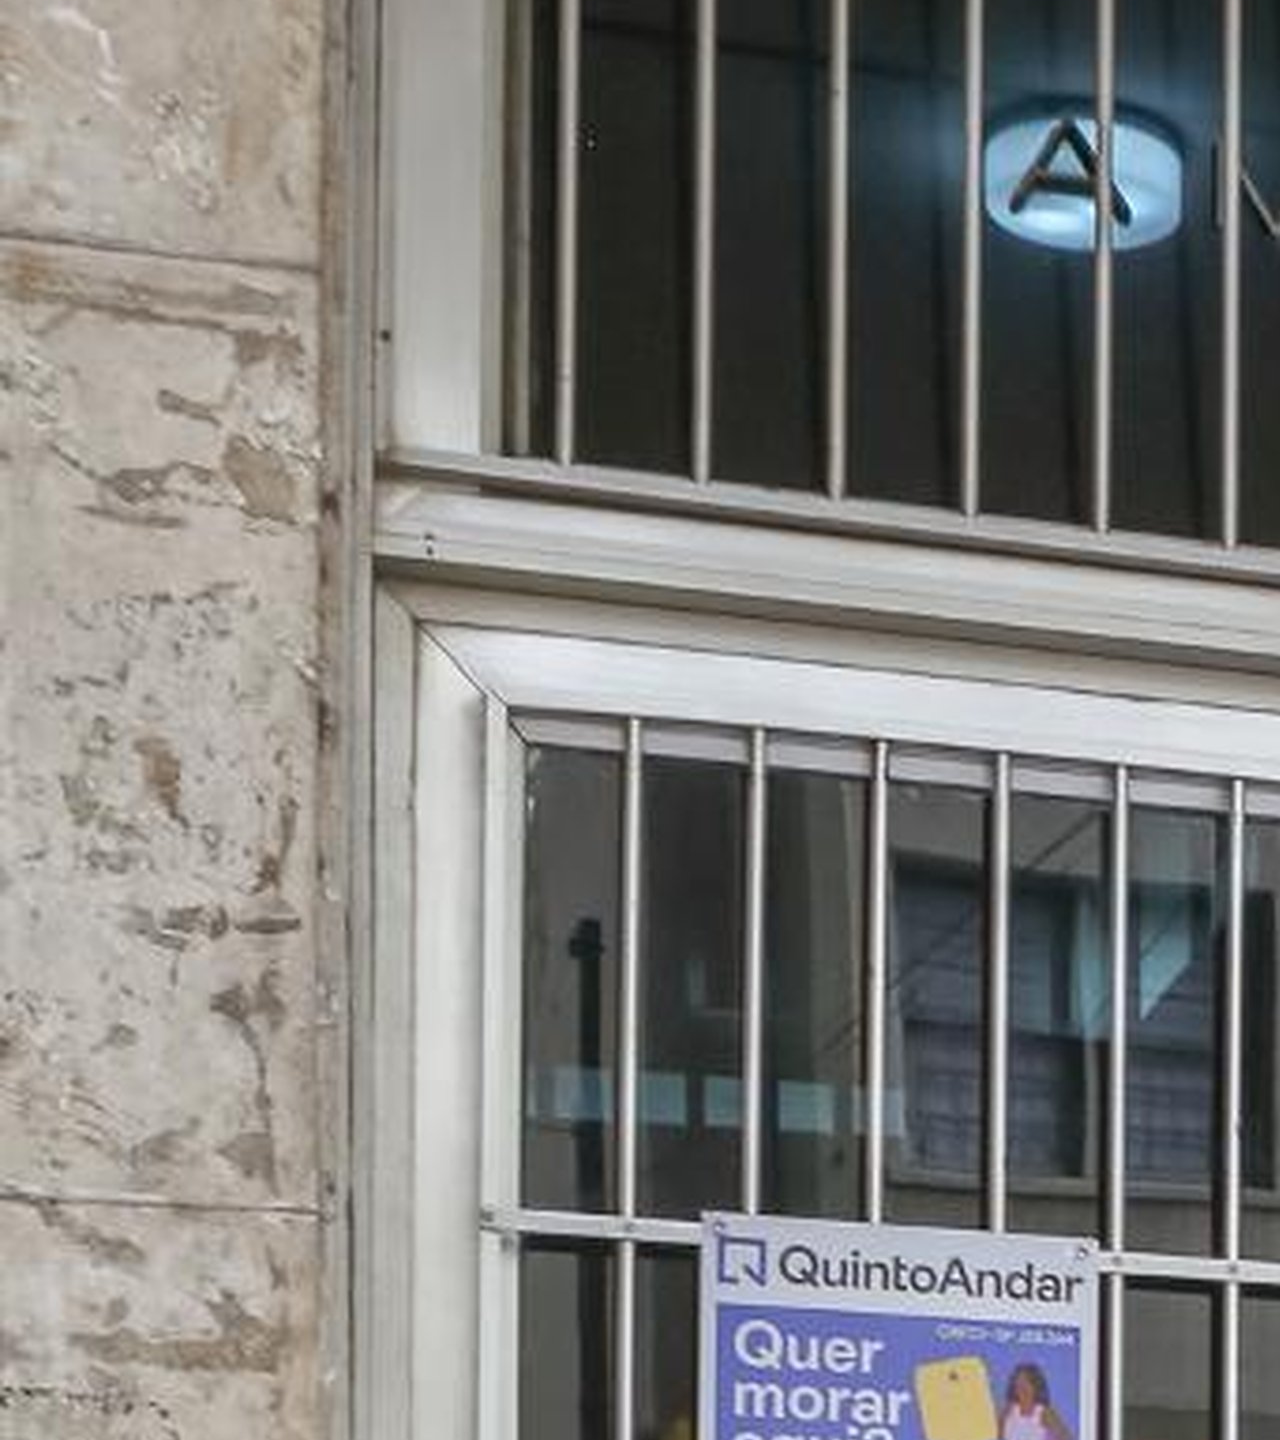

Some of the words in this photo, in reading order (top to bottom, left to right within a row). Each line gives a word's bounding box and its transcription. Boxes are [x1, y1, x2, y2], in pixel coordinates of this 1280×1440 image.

[777, 1244, 1084, 1304] QuintoAndar
[733, 1318, 884, 1374] Quer
[733, 1379, 910, 1428] morar
